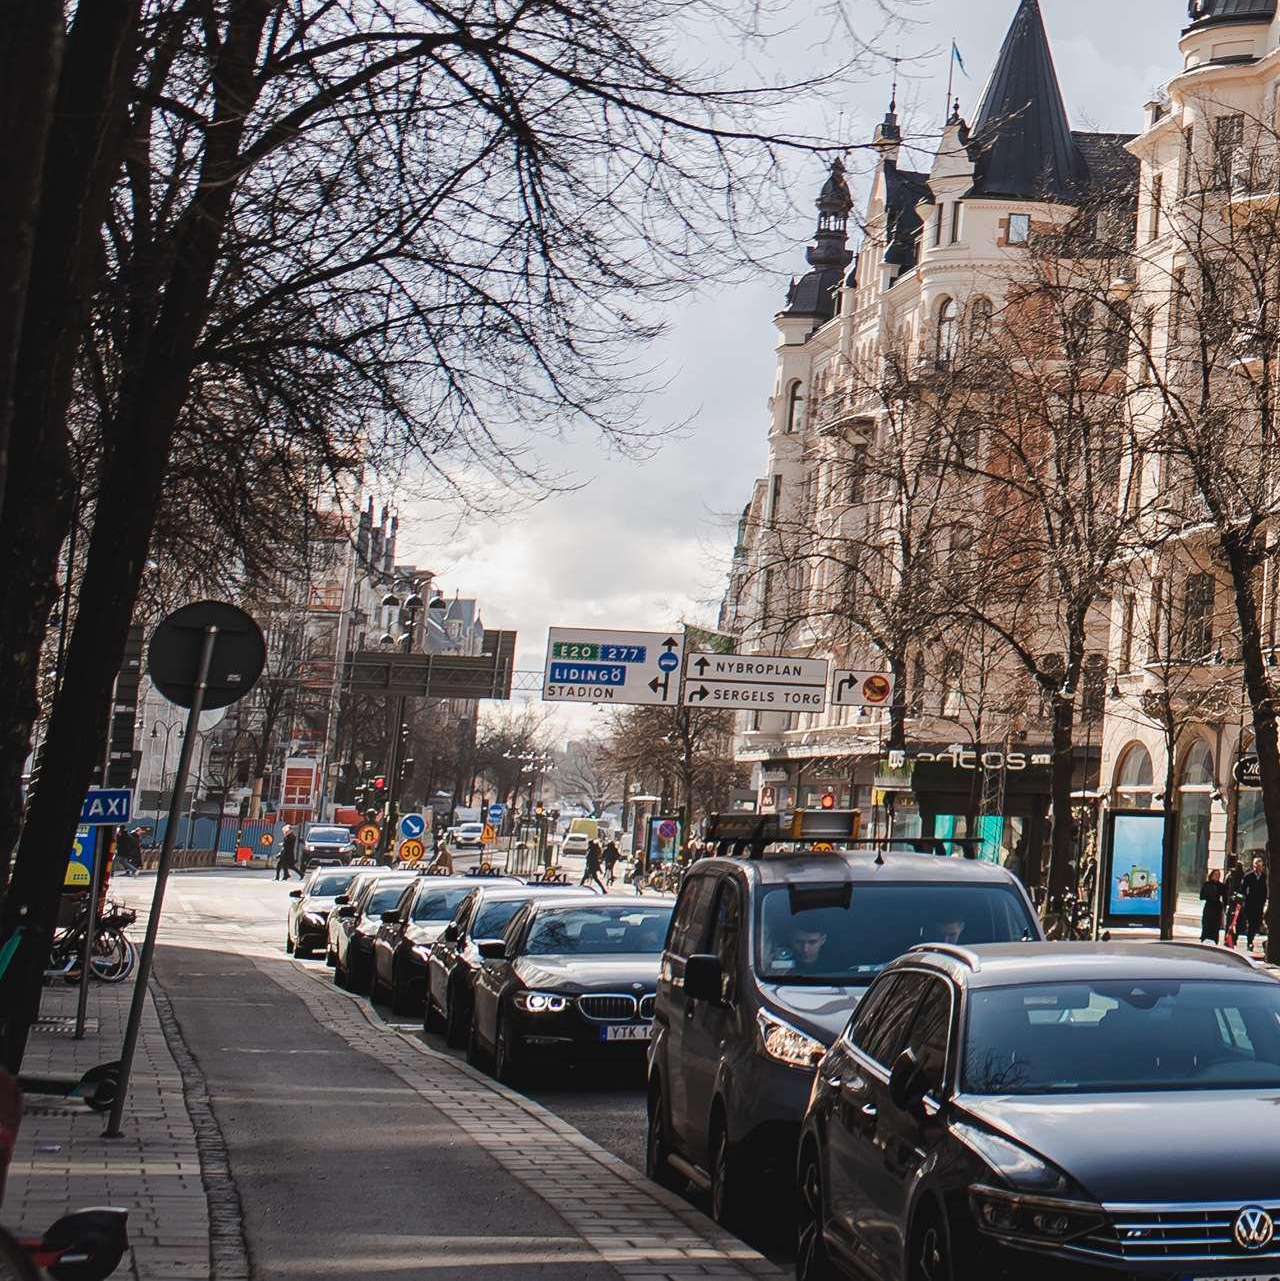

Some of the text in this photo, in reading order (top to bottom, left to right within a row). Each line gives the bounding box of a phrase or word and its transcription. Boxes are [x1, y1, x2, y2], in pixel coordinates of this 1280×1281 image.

[560, 644, 592, 658] E20
[608, 648, 639, 659] 277
[554, 667, 621, 682] LIDINGÖ
[716, 661, 802, 677] NYBROPLAN
[547, 685, 615, 699] STADION
[713, 688, 822, 705] SERGELS TORG
[403, 845, 420, 857] 30
